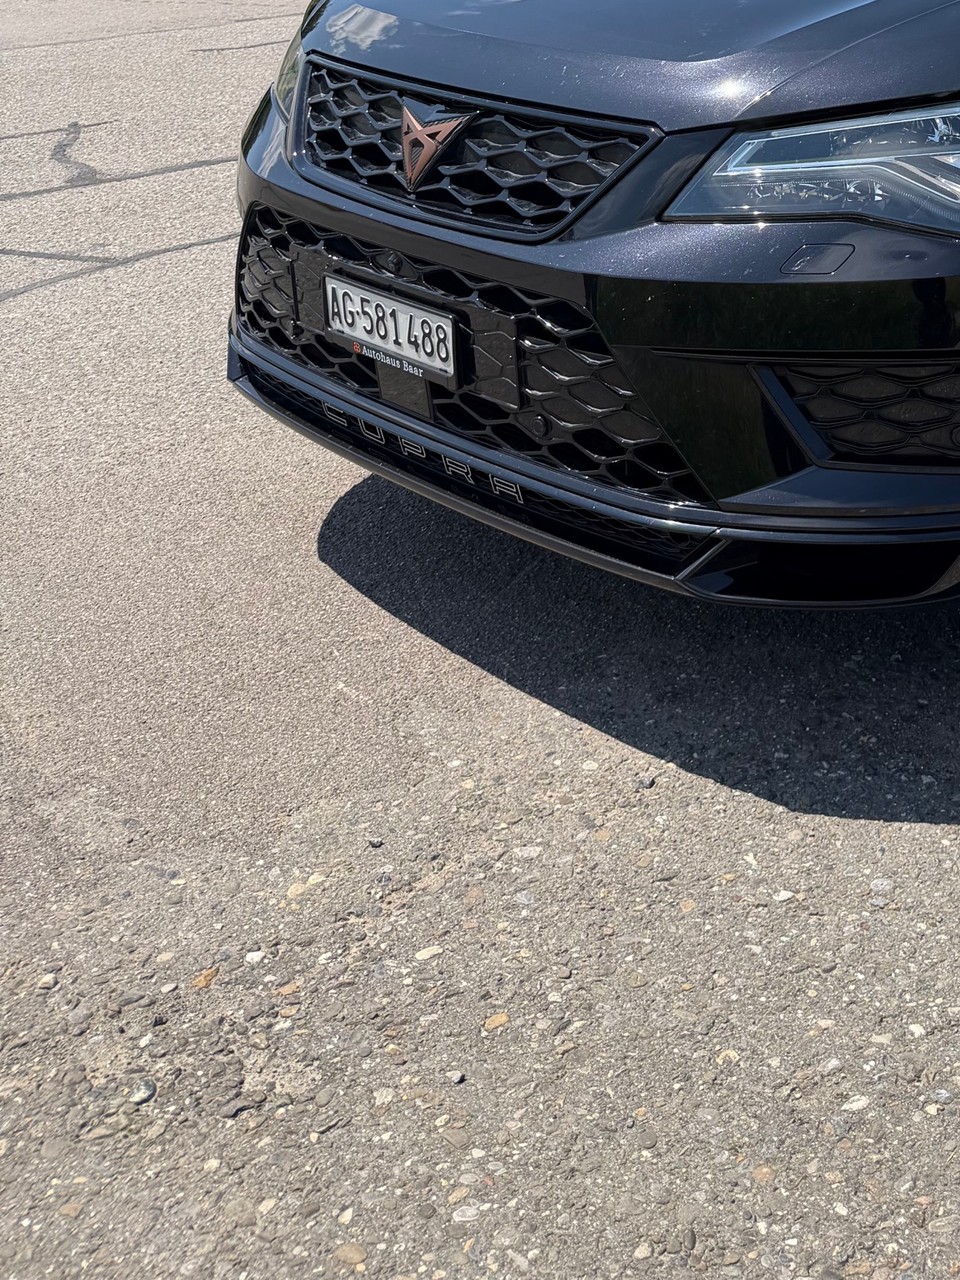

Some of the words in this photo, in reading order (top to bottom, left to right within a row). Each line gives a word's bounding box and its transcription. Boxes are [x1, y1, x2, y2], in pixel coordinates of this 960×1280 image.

[362, 345, 401, 369] Autohaus
[402, 360, 424, 377] Baar
[321, 400, 524, 504] CUPRA
